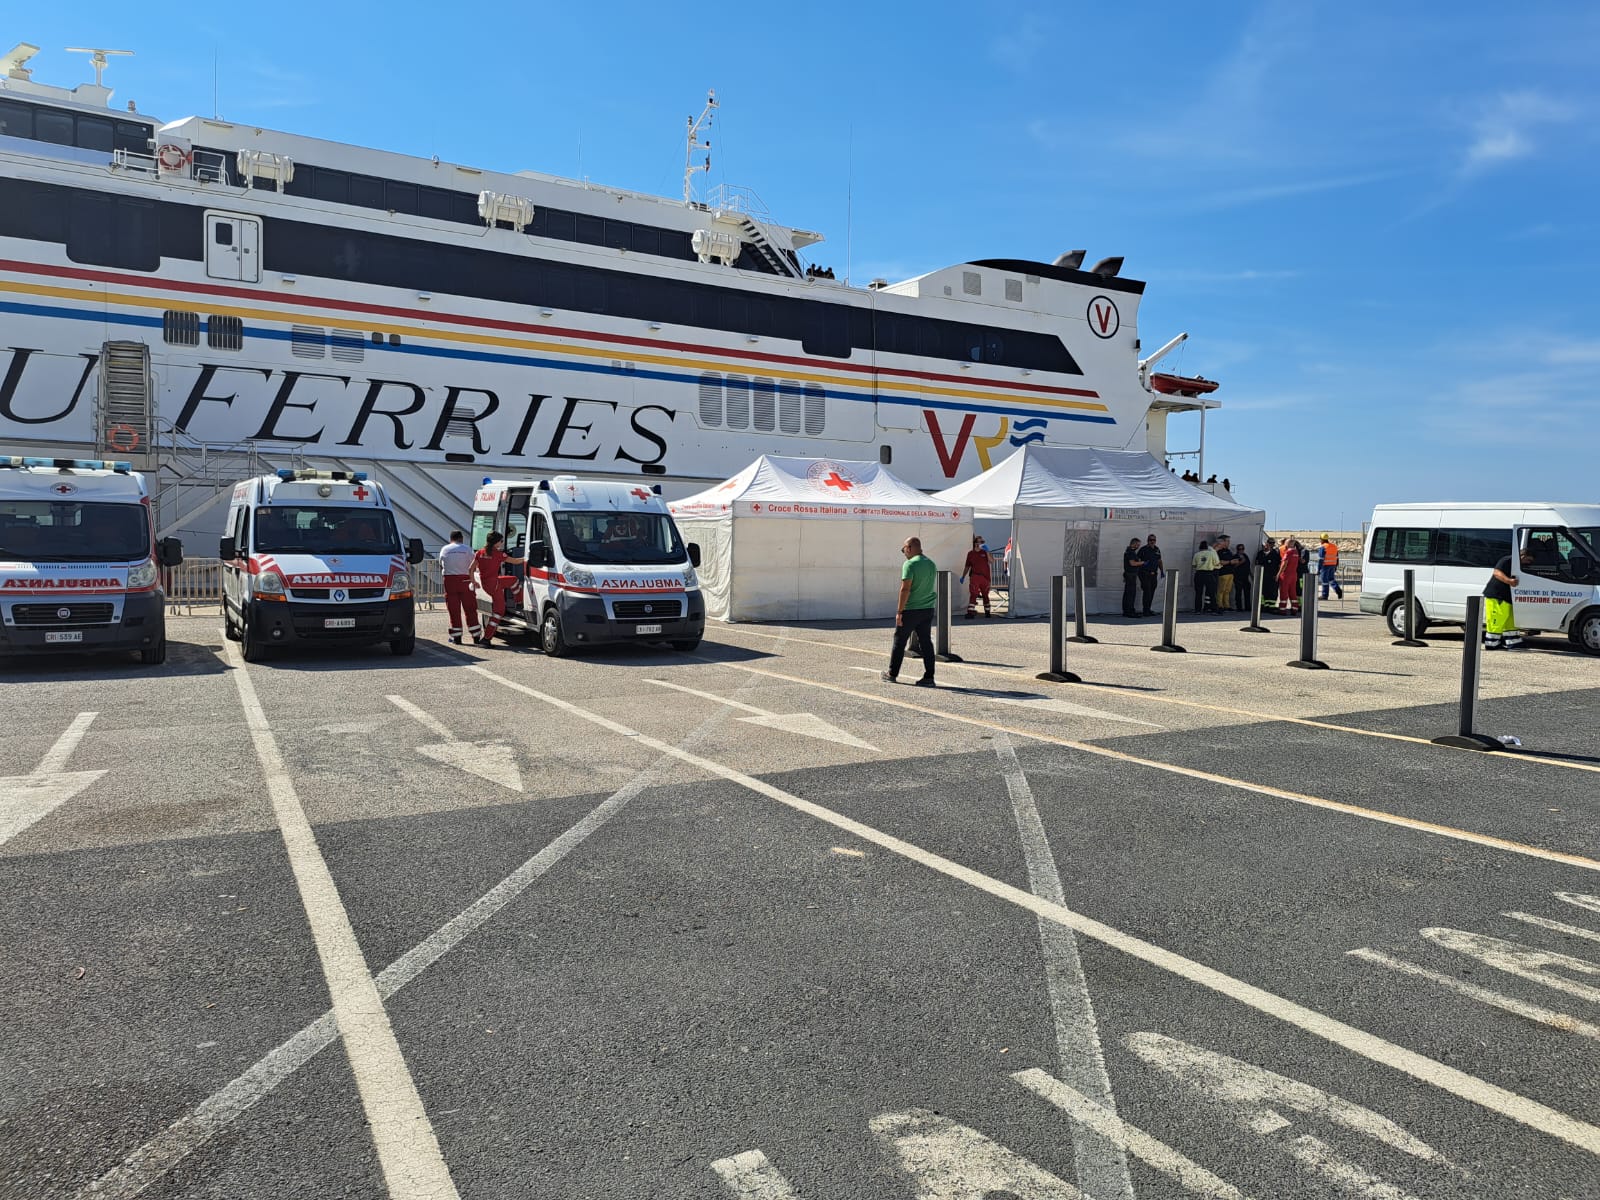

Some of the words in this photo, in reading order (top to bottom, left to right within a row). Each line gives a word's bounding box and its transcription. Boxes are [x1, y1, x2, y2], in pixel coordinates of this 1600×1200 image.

[1095, 303, 1112, 334] V
[164, 362, 677, 466] FERRIES
[768, 503, 791, 513] Croce
[793, 504, 818, 513] Rossa
[820, 505, 847, 514] Italiana
[1514, 588, 1540, 596] COMUNE
